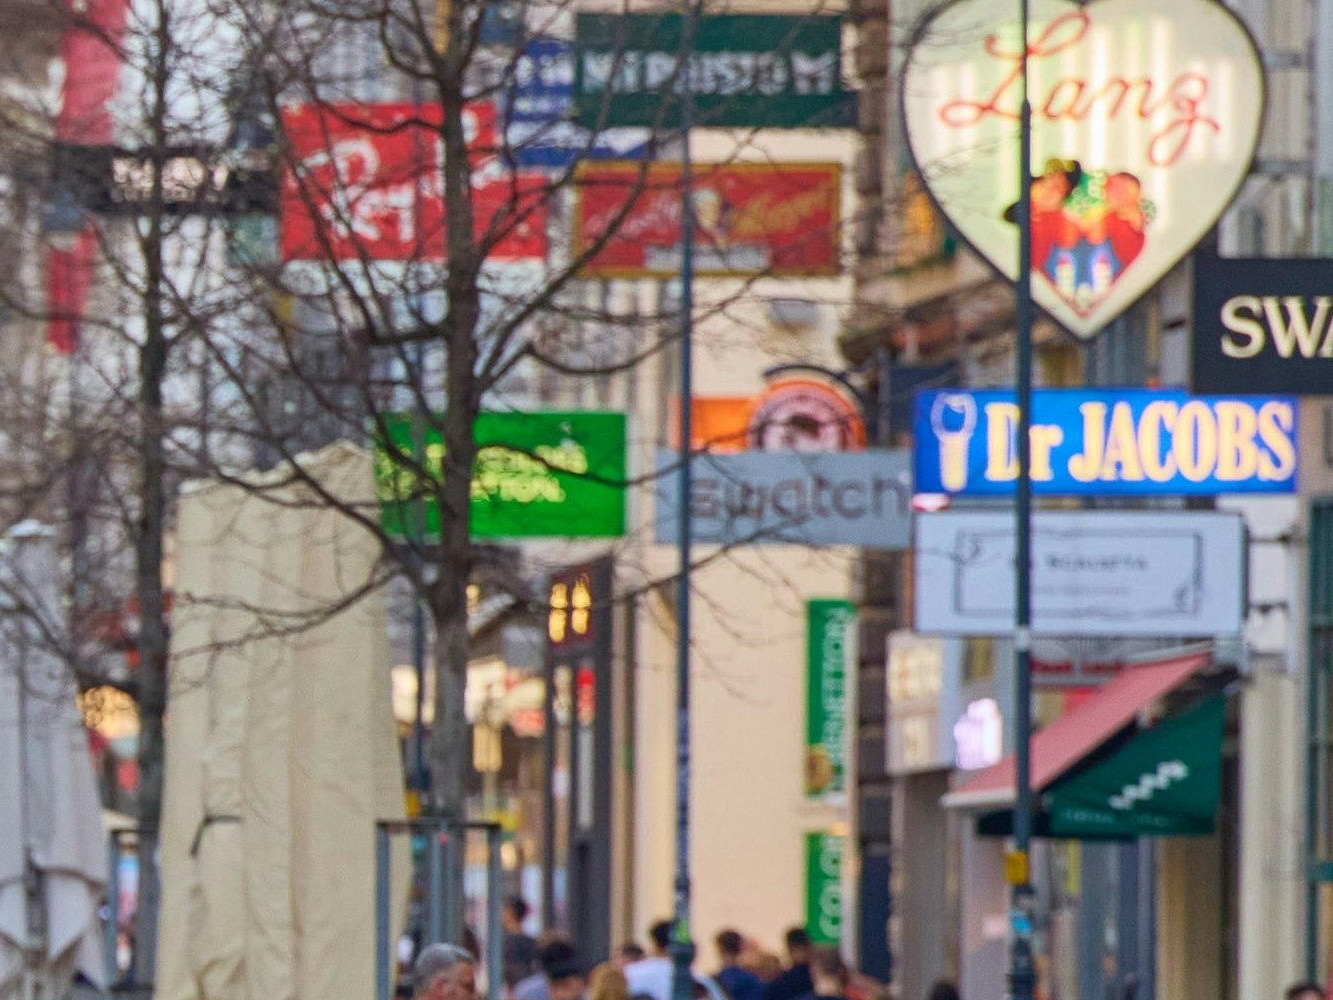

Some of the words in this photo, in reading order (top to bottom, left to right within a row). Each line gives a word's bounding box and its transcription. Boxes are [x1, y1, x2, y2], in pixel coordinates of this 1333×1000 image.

[938, 10, 1221, 167] Lang
[984, 403, 1061, 481] Dr
[1068, 401, 1295, 482] JACOBS
